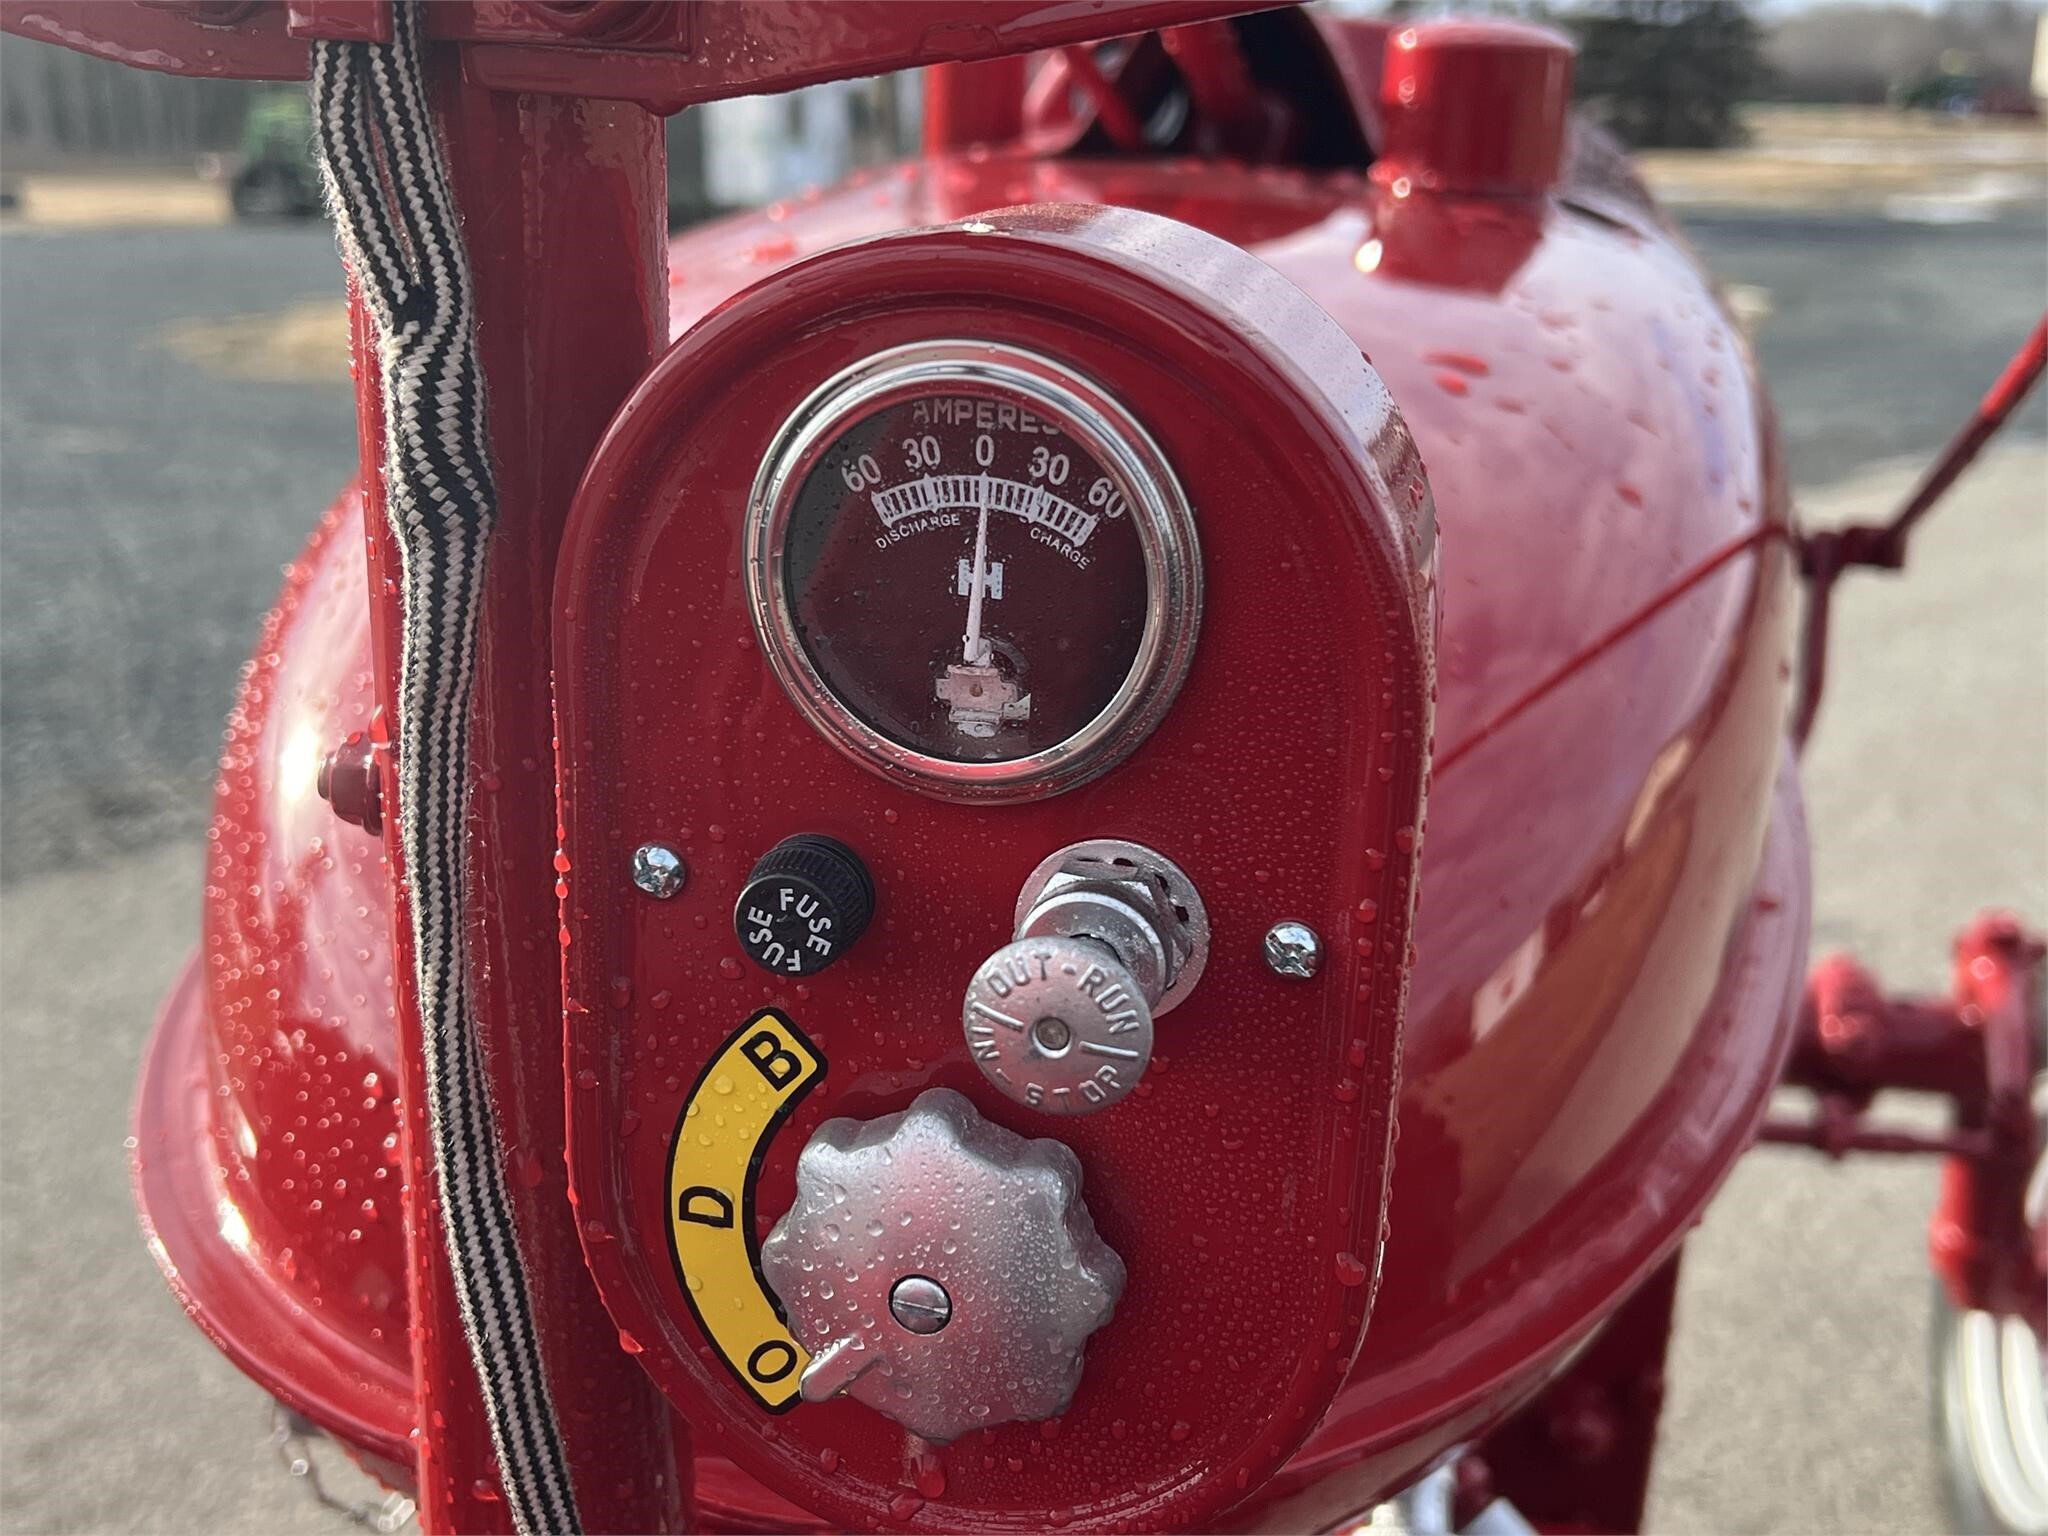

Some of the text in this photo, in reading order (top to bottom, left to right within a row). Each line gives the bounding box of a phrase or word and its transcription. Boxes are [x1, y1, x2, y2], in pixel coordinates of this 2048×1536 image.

[841, 434, 1127, 519] 60 30 0 30 60
[875, 512, 961, 550] DISCHARGE
[1029, 526, 1091, 571] CHARGE
[747, 906, 801, 971] FUSE
[779, 888, 832, 957] FUSE
[740, 1030, 801, 1092] B
[679, 1186, 734, 1228] D
